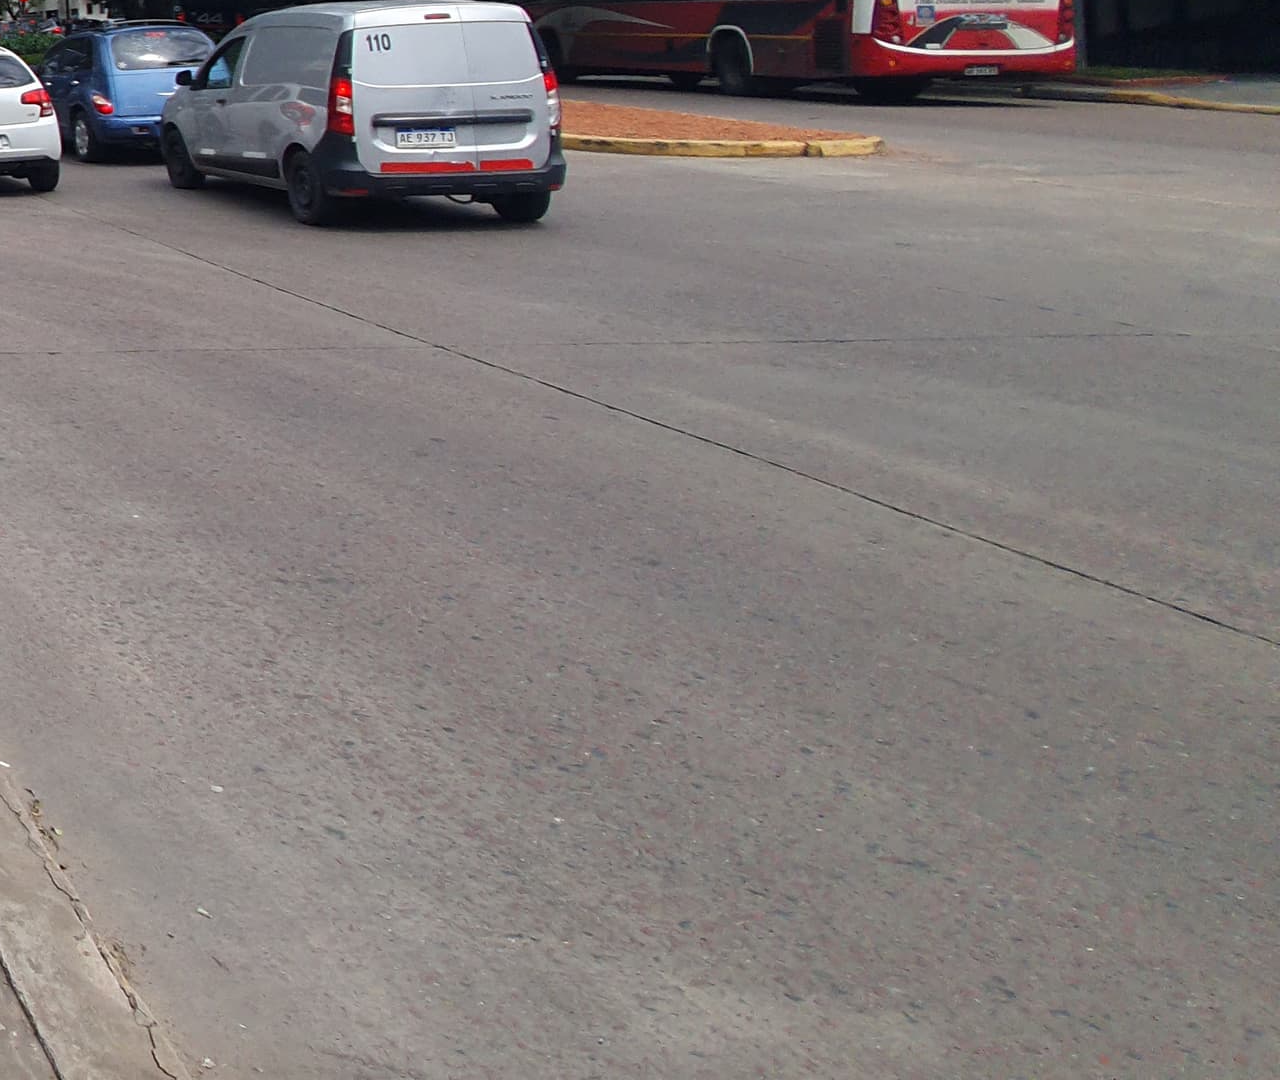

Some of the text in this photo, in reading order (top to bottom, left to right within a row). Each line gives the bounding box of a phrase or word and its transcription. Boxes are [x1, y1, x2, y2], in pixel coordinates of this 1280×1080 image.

[366, 33, 391, 52] 110
[399, 132, 454, 143] AE 937 TJ
